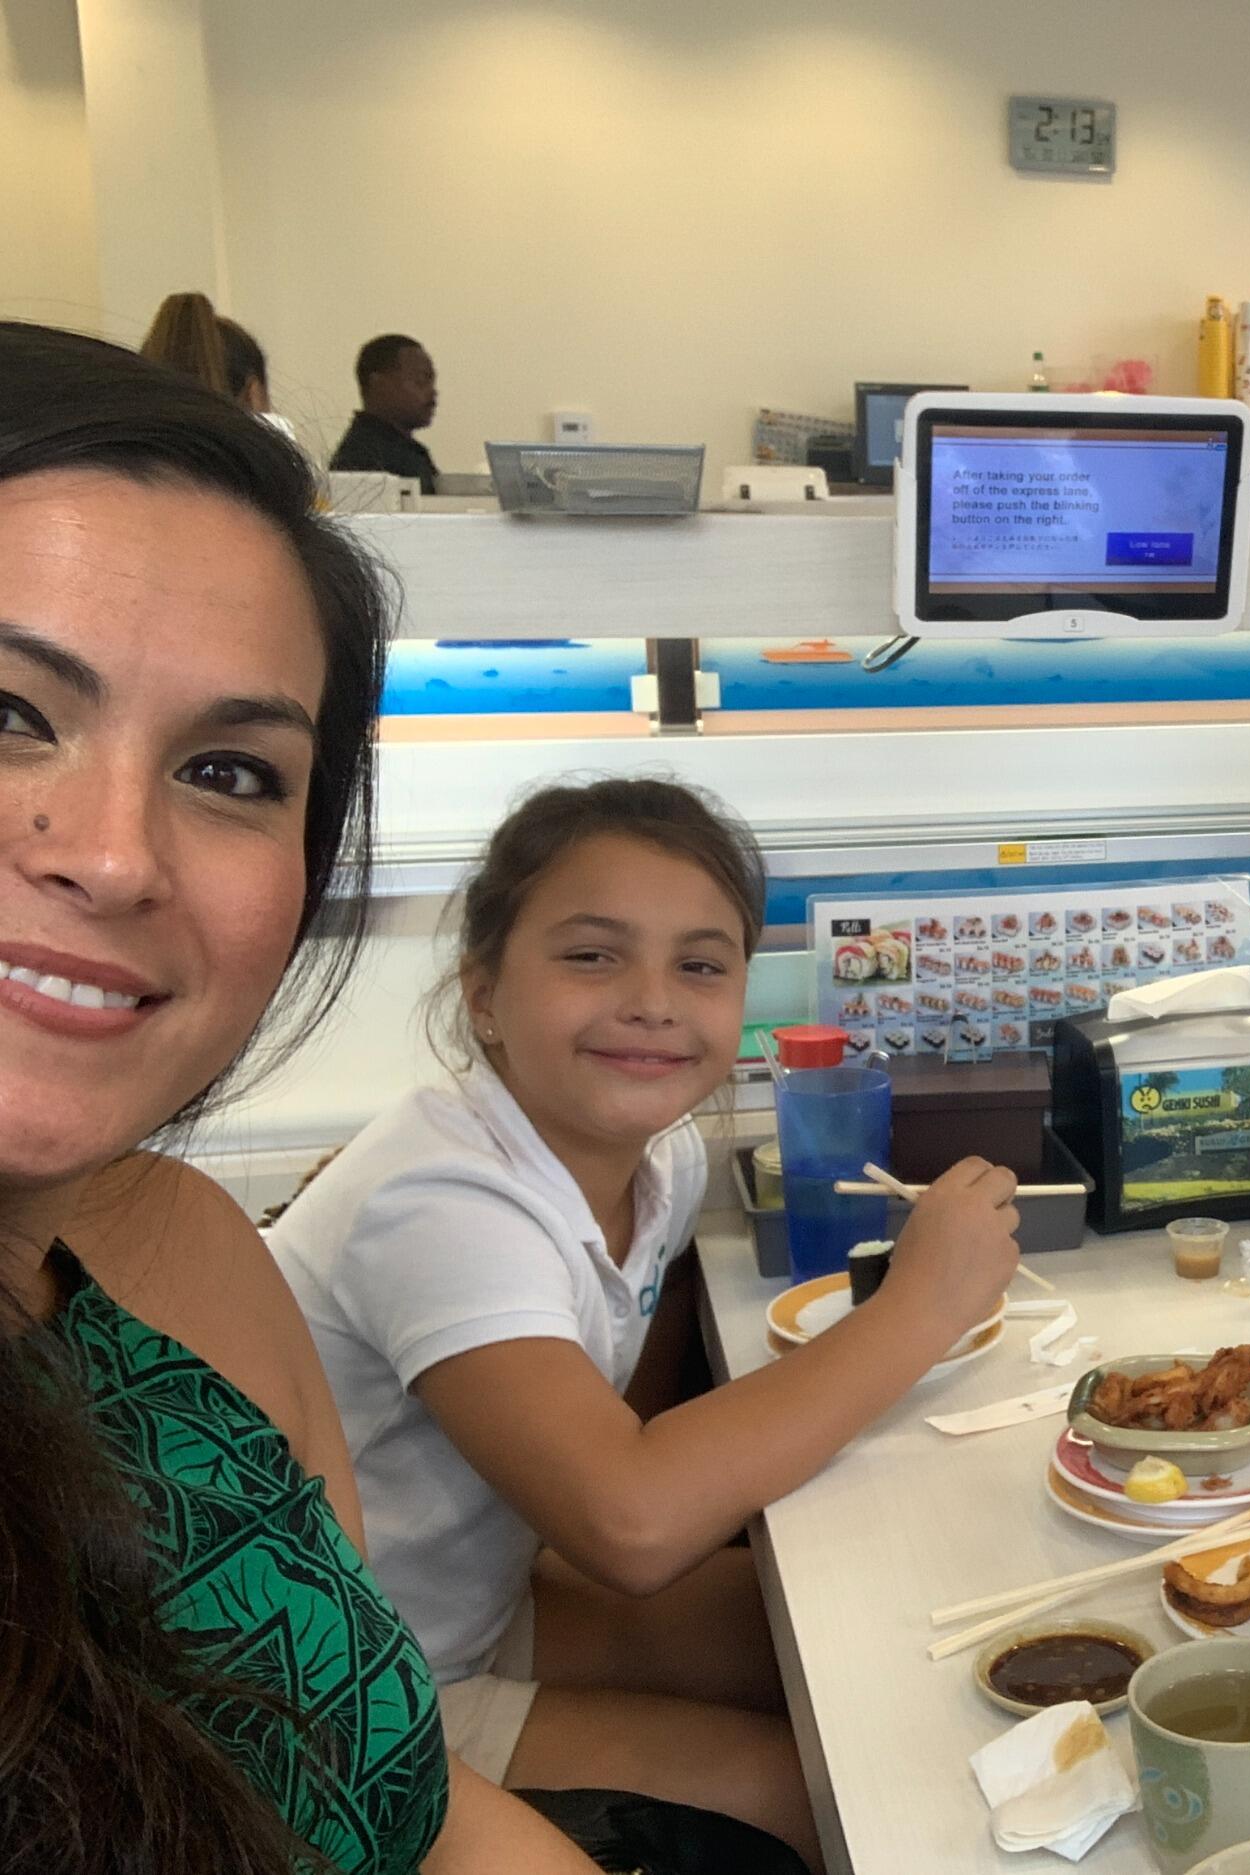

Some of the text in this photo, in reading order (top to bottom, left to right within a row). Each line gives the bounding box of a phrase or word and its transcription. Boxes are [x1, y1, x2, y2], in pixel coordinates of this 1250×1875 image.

[1034, 106, 1095, 144] 2:13
[953, 470, 1090, 483] After taking your order
[953, 485, 969, 495] off
[973, 485, 985, 495] of
[989, 485, 1008, 495] the
[1012, 487, 1059, 498] express
[952, 500, 1100, 513] please push the blinking
[952, 514, 990, 524] button
[994, 516, 1010, 524] on
[1013, 514, 1033, 524] the
[1070, 618, 1078, 628] 5
[1162, 1094, 1221, 1111] GENKI SUSHI
